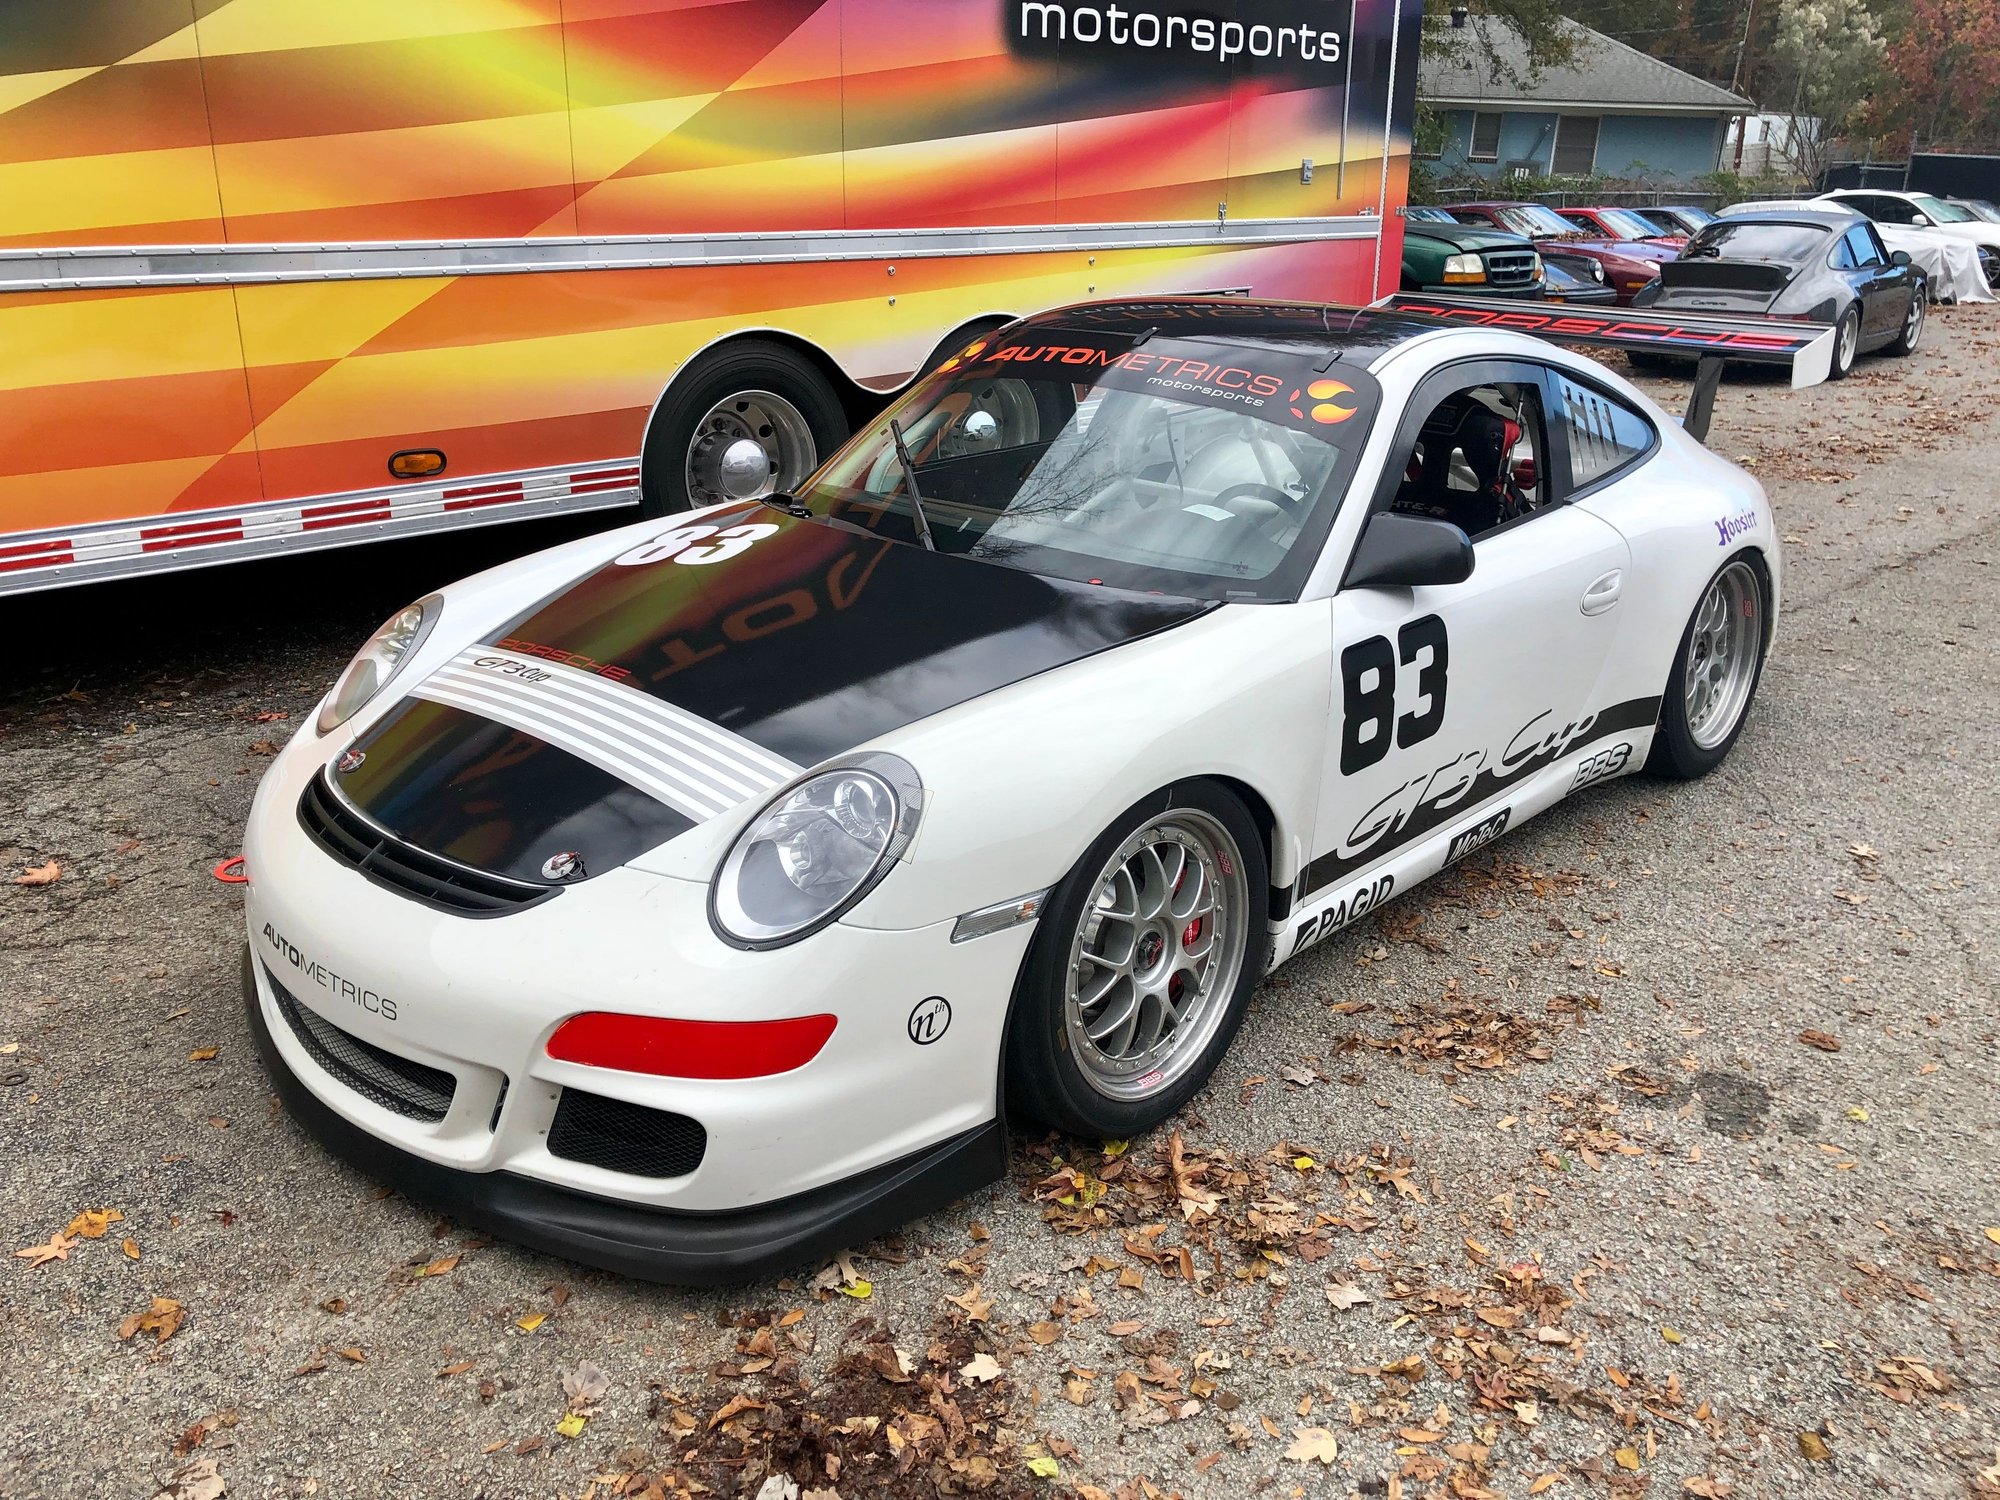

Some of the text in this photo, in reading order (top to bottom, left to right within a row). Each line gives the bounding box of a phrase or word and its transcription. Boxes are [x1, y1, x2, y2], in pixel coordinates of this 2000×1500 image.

[1021, 2, 1340, 63] motorsports
[984, 346, 1283, 396] AUTOMETRICS
[1147, 376, 1265, 407] motorsports
[614, 523, 780, 566] 83
[473, 656, 552, 683] GT3 Cup
[495, 638, 632, 682] PORSCHE
[1340, 614, 1449, 777] 83
[1337, 709, 1600, 860] GT3 Cup
[1566, 743, 1632, 795] BBS
[1450, 812, 1505, 861] MoTeC
[1314, 874, 1395, 942] PAGID
[263, 922, 398, 1021] AUTOMETRICS
[1137, 1070, 1164, 1087] BBS
